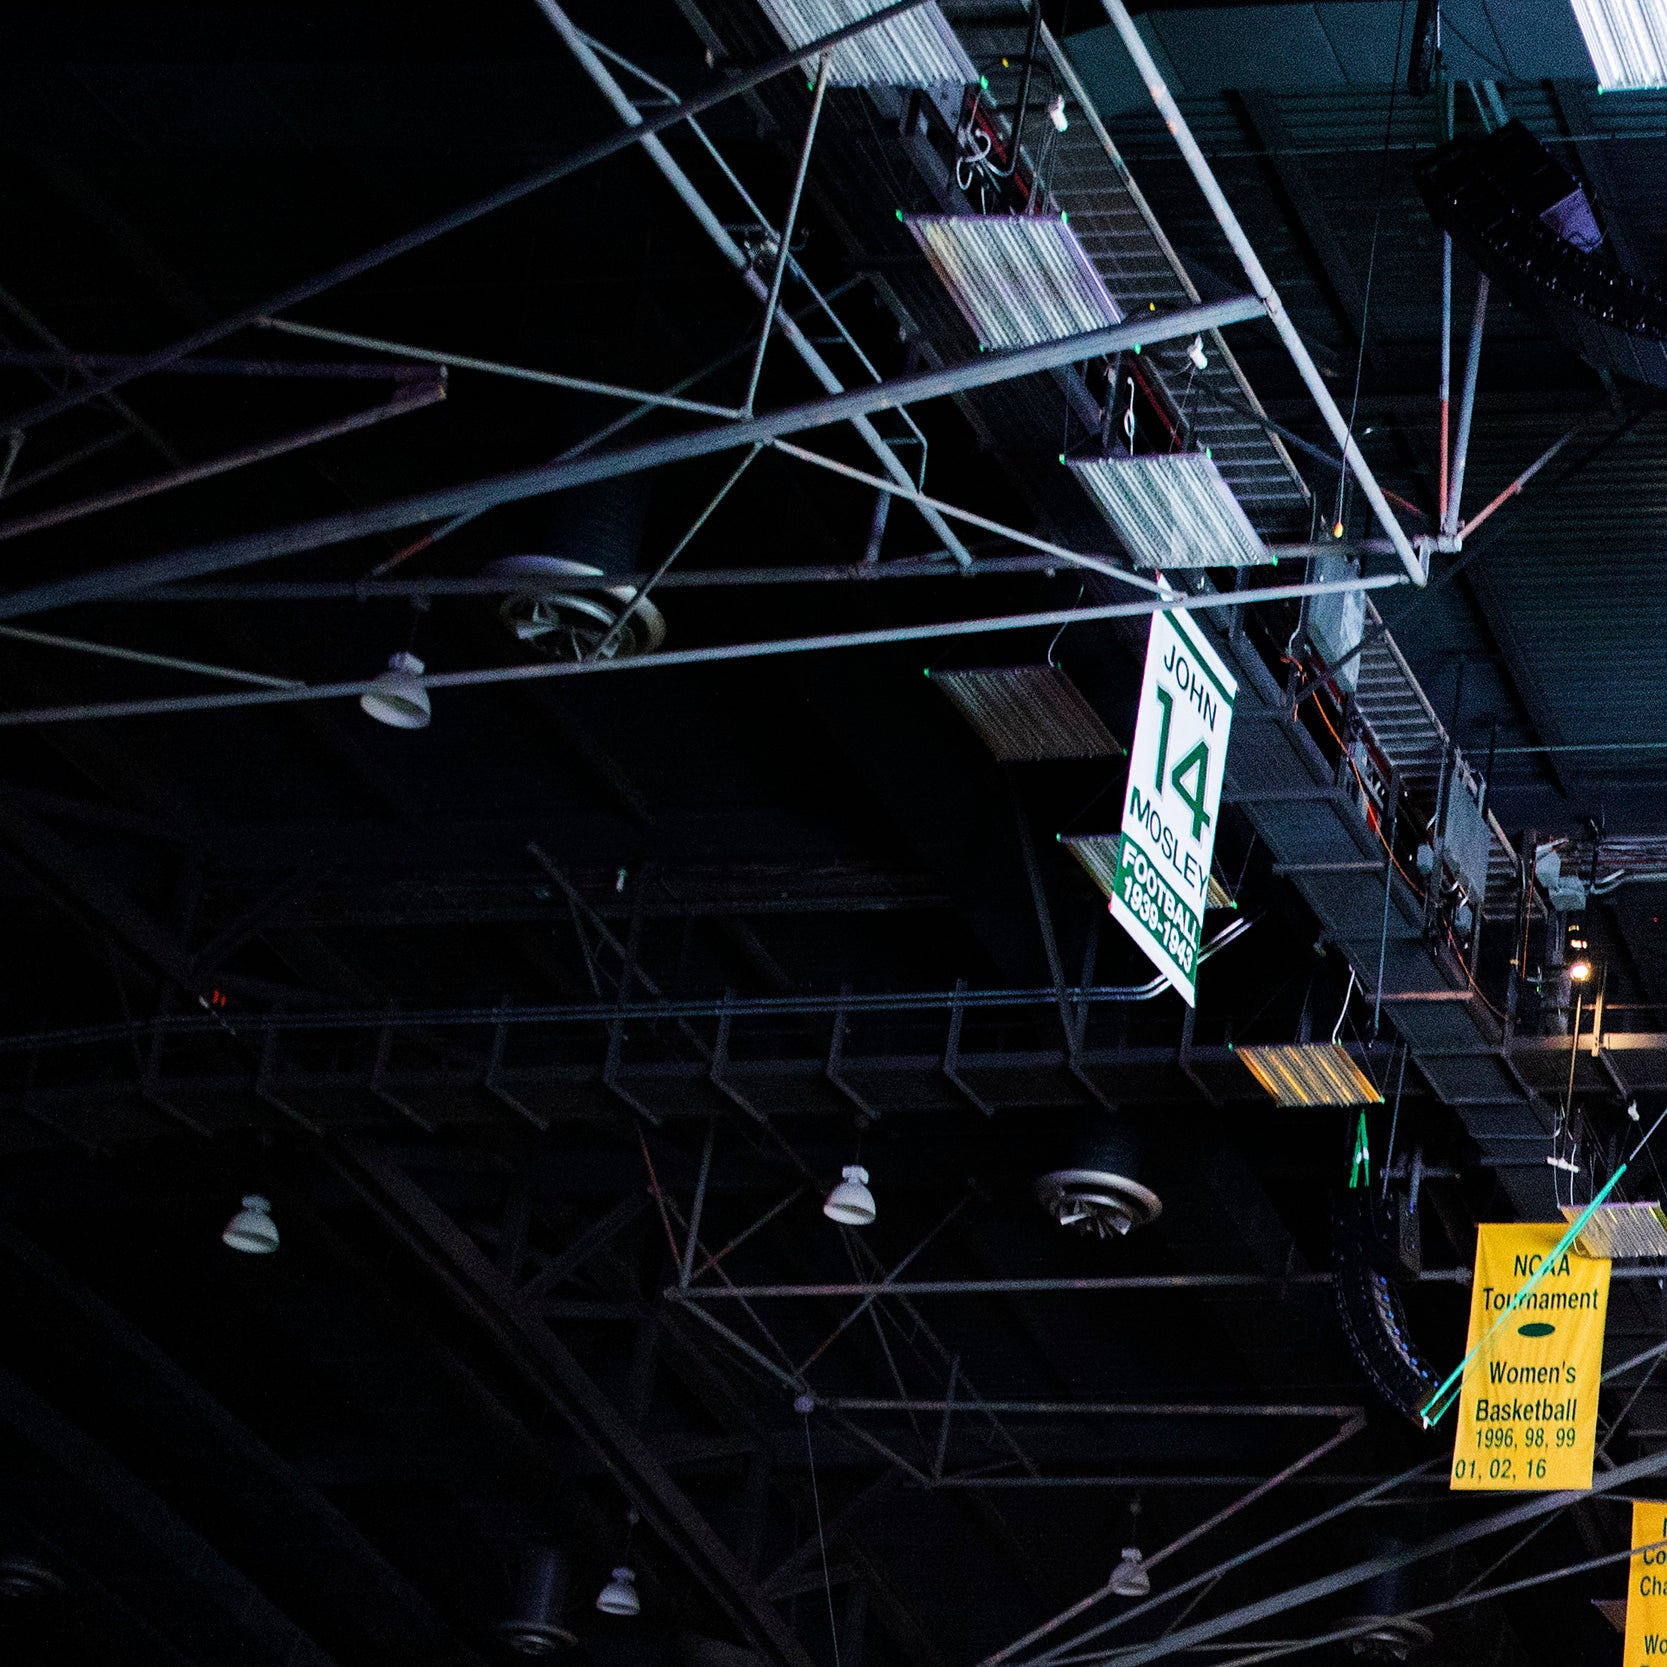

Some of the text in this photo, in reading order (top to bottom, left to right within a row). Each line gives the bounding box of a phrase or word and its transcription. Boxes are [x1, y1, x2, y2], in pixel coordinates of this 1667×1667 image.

[1164, 644, 1217, 733] JOHN
[1156, 685, 1211, 843] 14
[1129, 785, 1209, 899] MOSLEY
[1122, 841, 1197, 951] FOOTBALL
[1124, 876, 1193, 973] 1939-1943
[1514, 1254, 1570, 1277] NCAA
[1483, 1287, 1598, 1310] Tournament
[1489, 1360, 1576, 1384] Women's
[1475, 1398, 1577, 1422] Basketball
[1476, 1426, 1576, 1451] 1996, 98, 99
[1455, 1458, 1547, 1483] 01, 02, 16
